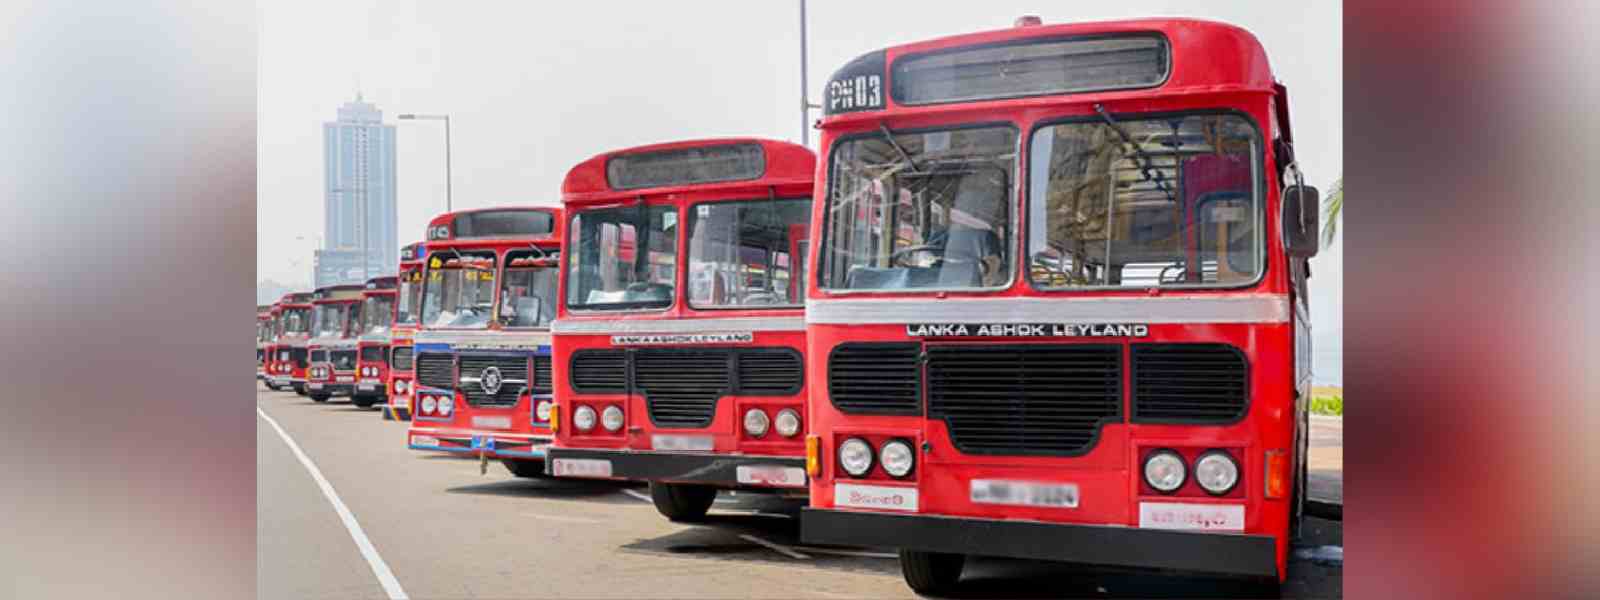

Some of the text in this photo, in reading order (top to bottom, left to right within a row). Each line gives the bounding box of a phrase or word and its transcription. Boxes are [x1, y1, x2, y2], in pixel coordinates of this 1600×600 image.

[906, 324, 1149, 337] LANKA ASHOK LEYLAND
[612, 333, 753, 344] LANKA ASHOK LEYLAND
